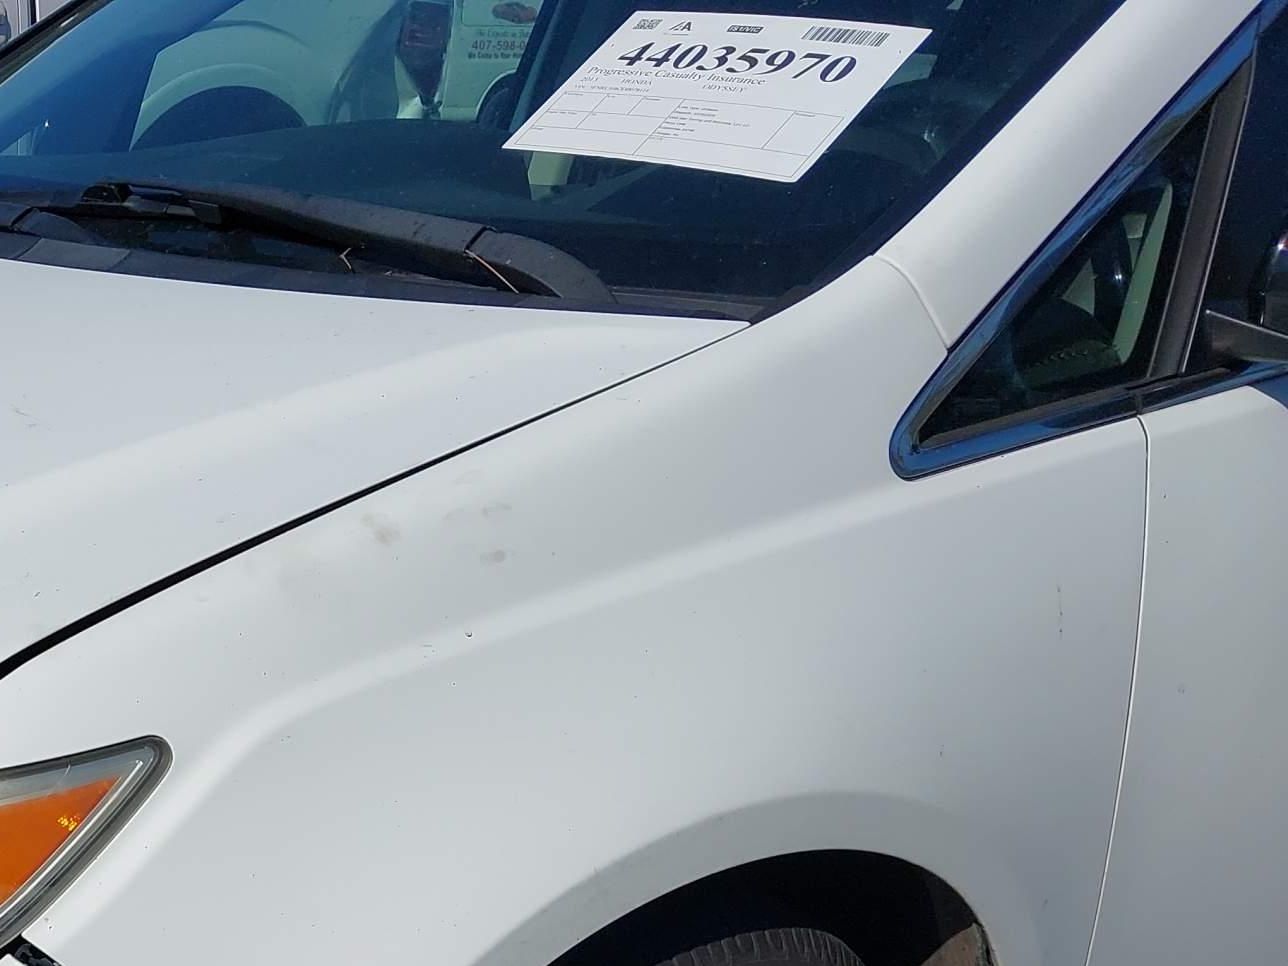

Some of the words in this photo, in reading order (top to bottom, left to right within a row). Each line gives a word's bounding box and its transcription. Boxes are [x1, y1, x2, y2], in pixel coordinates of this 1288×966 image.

[587, 66, 653, 79] Progressive
[654, 69, 706, 82] Casualty
[706, 73, 767, 86] Insurance
[617, 41, 858, 83] 44035970
